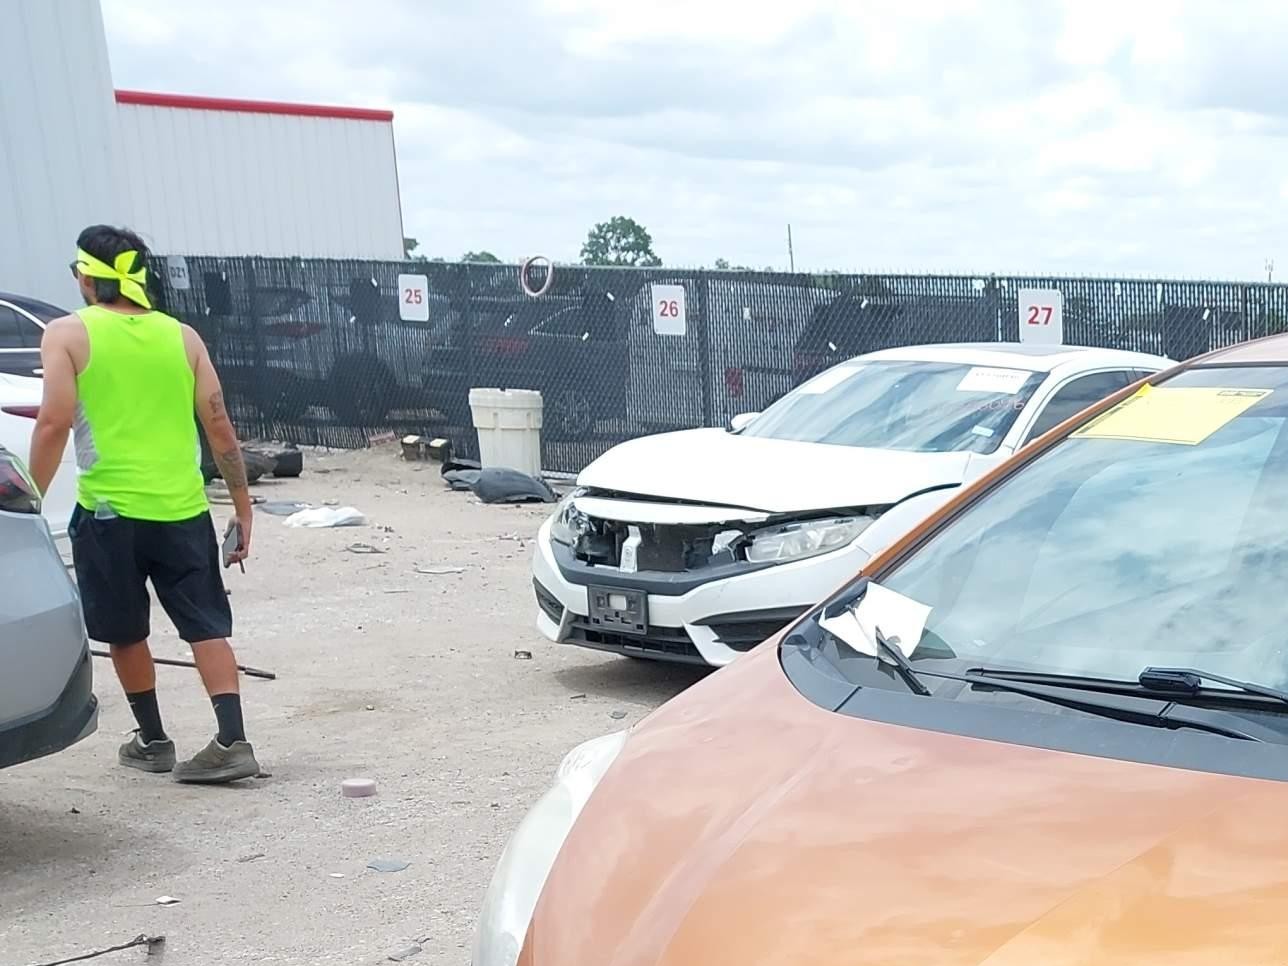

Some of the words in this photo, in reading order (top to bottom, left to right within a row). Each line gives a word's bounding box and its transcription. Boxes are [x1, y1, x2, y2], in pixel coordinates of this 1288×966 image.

[405, 288, 422, 305] 25
[659, 300, 679, 317] 26
[1028, 306, 1053, 325] 27
